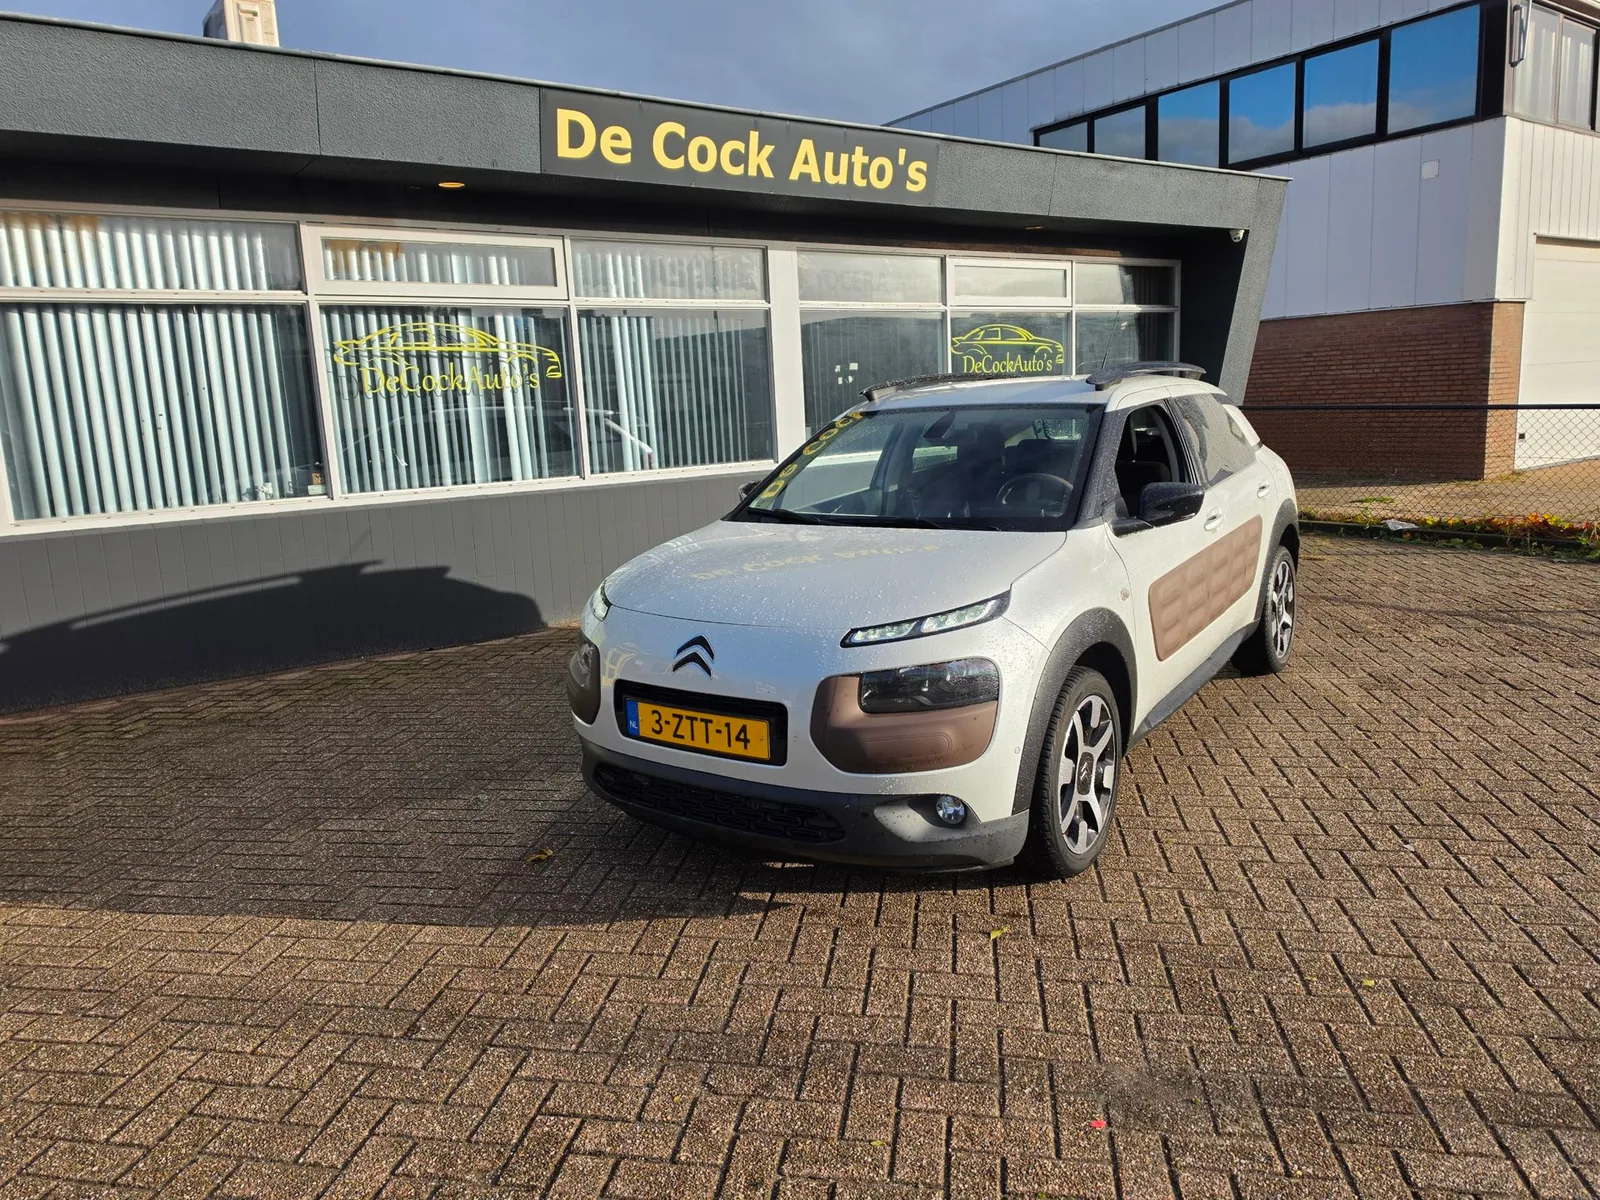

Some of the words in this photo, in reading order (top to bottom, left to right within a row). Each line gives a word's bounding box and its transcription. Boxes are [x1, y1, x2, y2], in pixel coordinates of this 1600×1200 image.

[556, 108, 632, 164] De
[652, 121, 775, 178] Cock
[788, 138, 928, 192] Auto's
[360, 362, 541, 394] DeCockAuto's
[962, 352, 1053, 373] DeCockAuto's
[629, 720, 638, 729] NL
[651, 709, 750, 750] 3-ZTT-14
